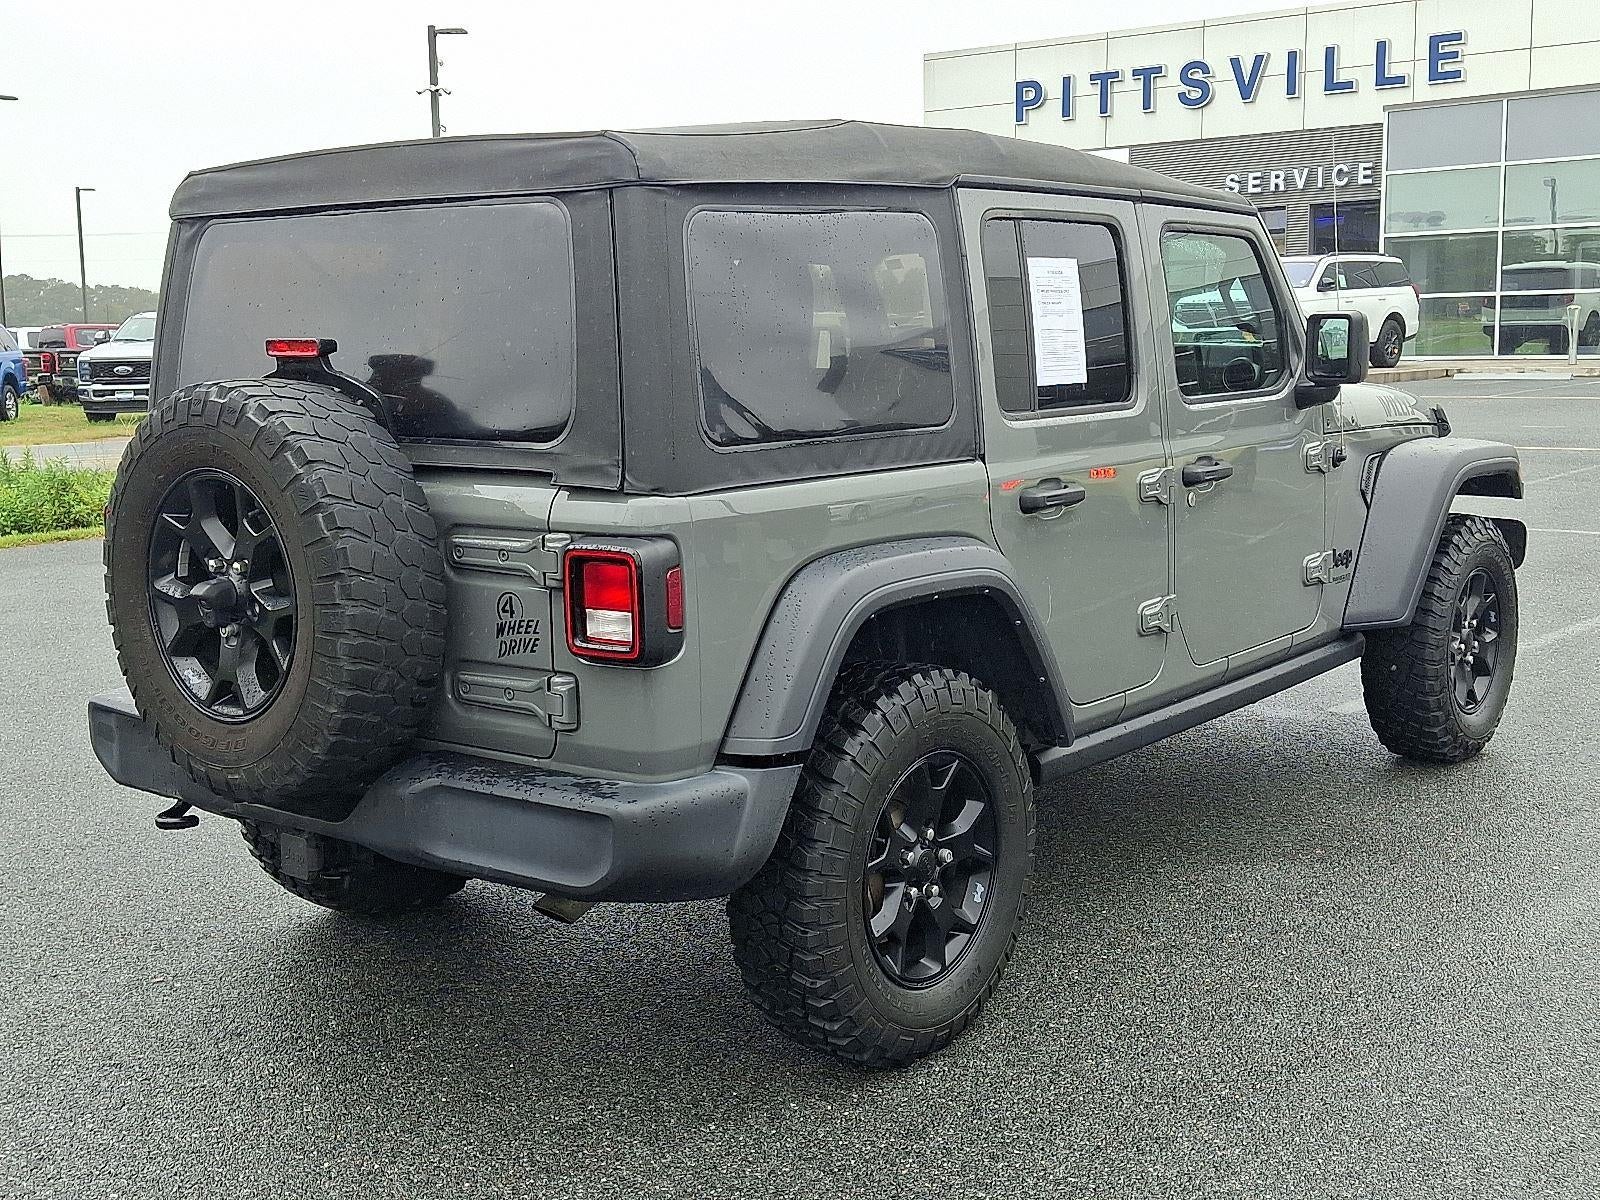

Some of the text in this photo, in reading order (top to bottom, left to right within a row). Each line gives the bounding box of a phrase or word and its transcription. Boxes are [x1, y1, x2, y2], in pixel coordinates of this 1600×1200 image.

[1014, 29, 1467, 125] PITTSVILLE
[1224, 161, 1374, 193] SERVICE
[501, 595, 516, 619] 4
[495, 619, 540, 639] WHEEL
[497, 637, 541, 658] DRIVE
